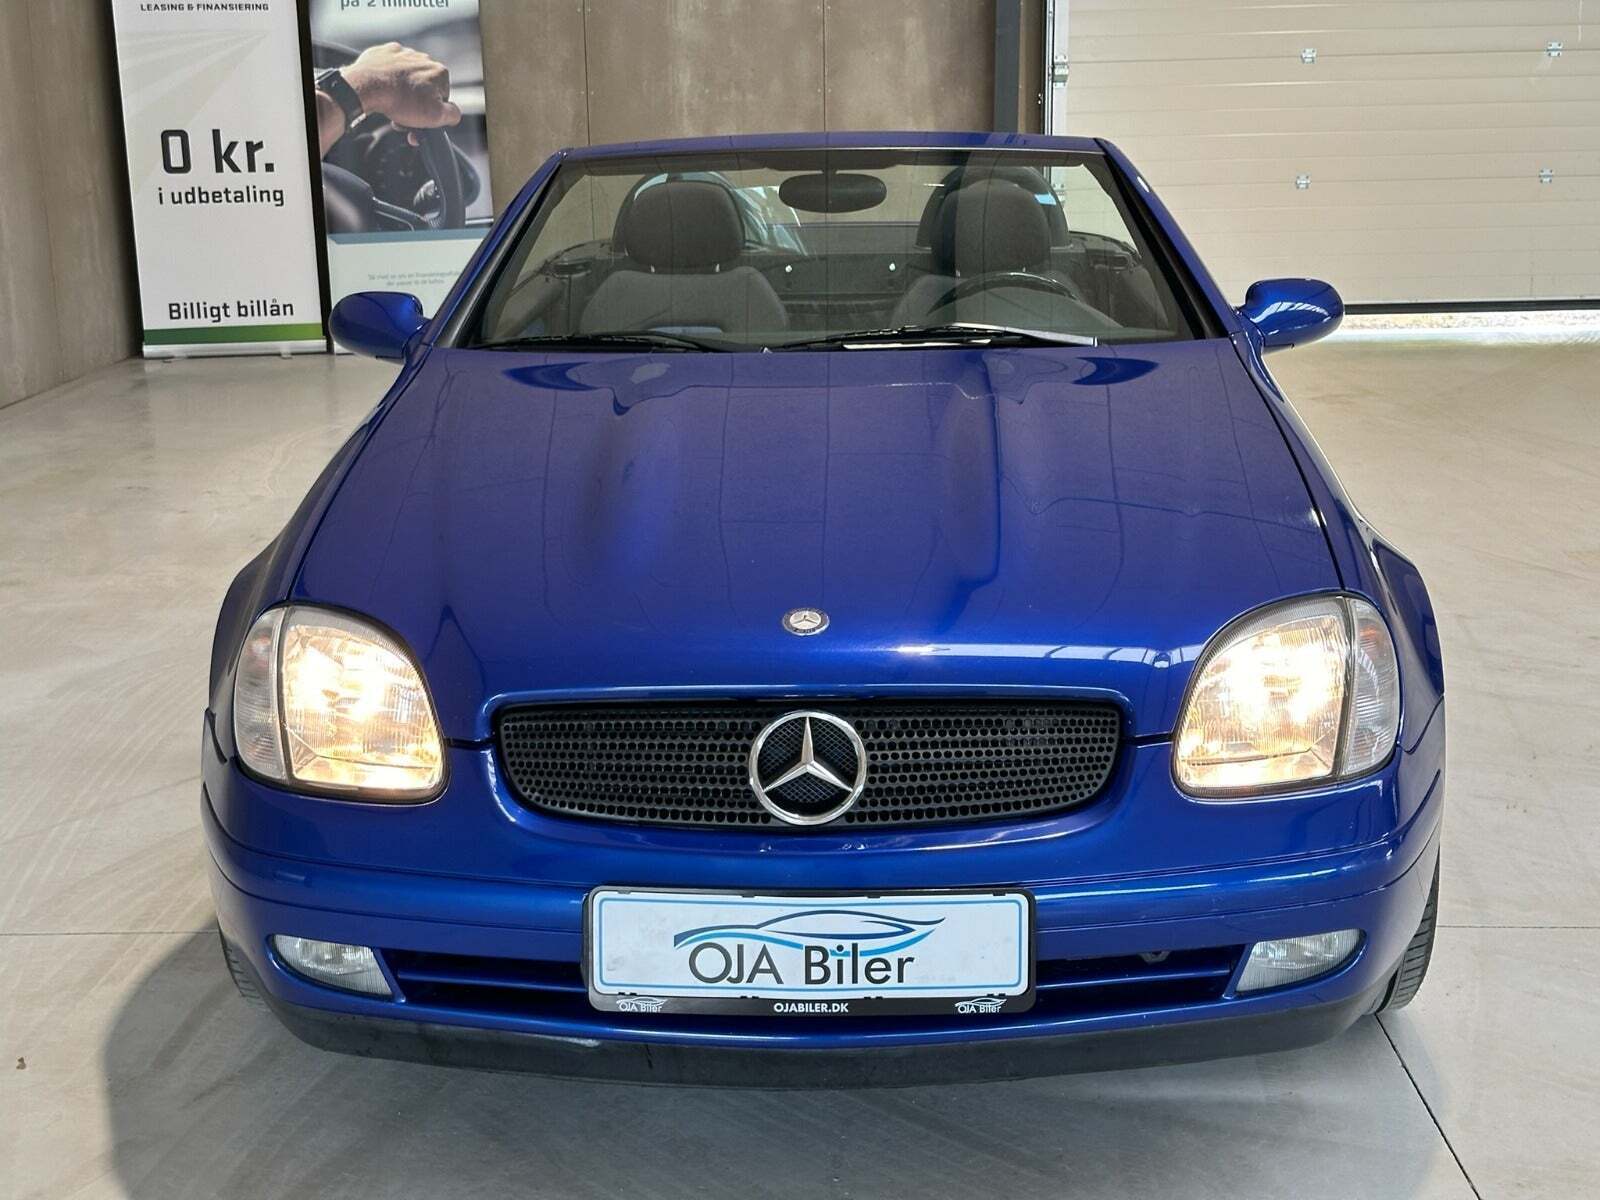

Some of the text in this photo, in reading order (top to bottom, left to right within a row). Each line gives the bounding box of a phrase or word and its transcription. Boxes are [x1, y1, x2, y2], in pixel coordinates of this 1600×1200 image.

[140, 3, 269, 11] LEASING & FINANSIERING
[160, 128, 275, 174] 0 kr.
[158, 185, 285, 206] i udbetaling
[168, 298, 295, 322] Billigt billån
[688, 941, 915, 985] OJA Biler
[773, 1002, 849, 1013] OJABILER.DK
[957, 1002, 977, 1013] OJA
